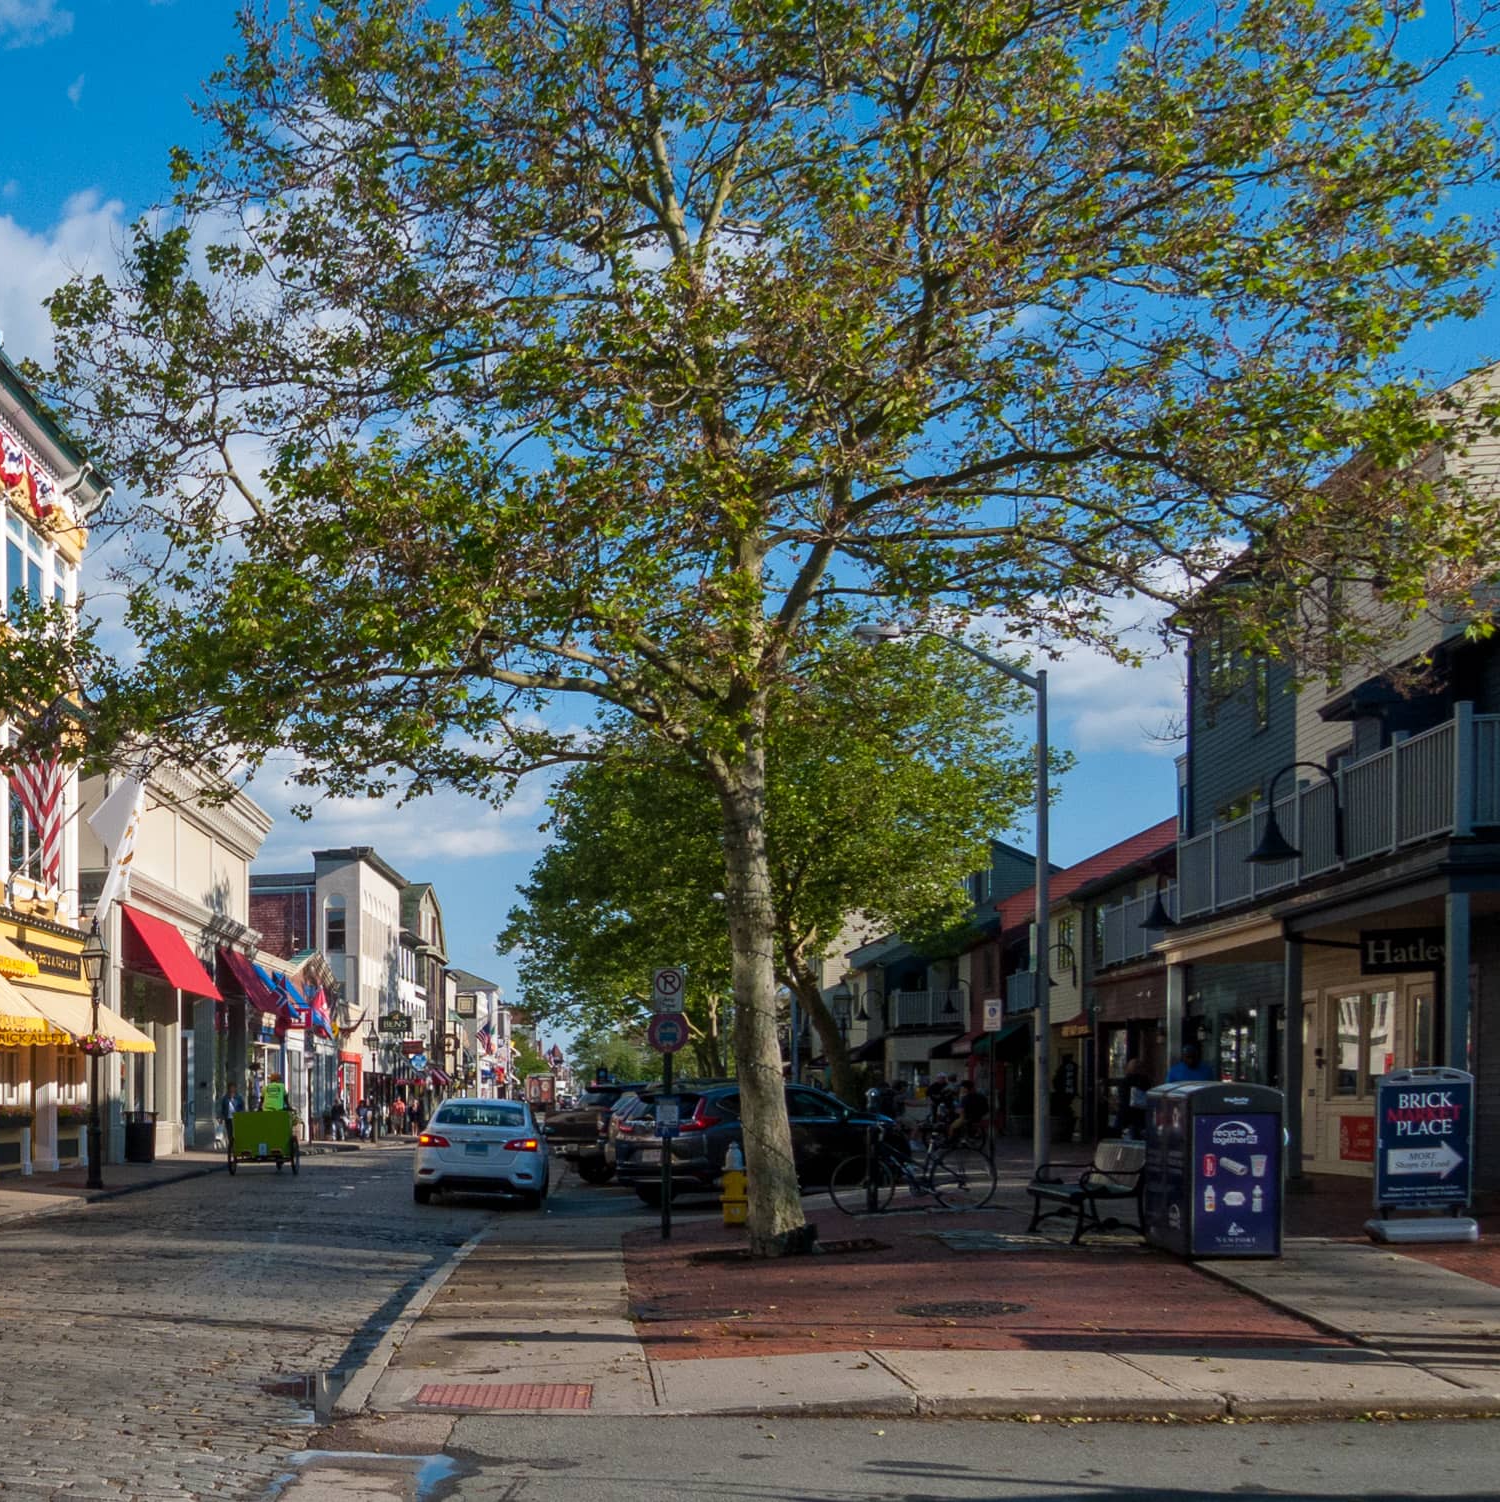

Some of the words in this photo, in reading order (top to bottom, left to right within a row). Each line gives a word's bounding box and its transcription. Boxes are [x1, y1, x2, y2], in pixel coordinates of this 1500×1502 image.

[29, 1033, 66, 1042] ALLEY
[1398, 1092, 1453, 1109] BRICK
[1387, 1104, 1463, 1122] MARKET
[1396, 1119, 1453, 1136] PLACE
[1213, 1128, 1246, 1140] recycle
[1213, 1136, 1246, 1146] together
[1410, 1152, 1437, 1160] MORE
